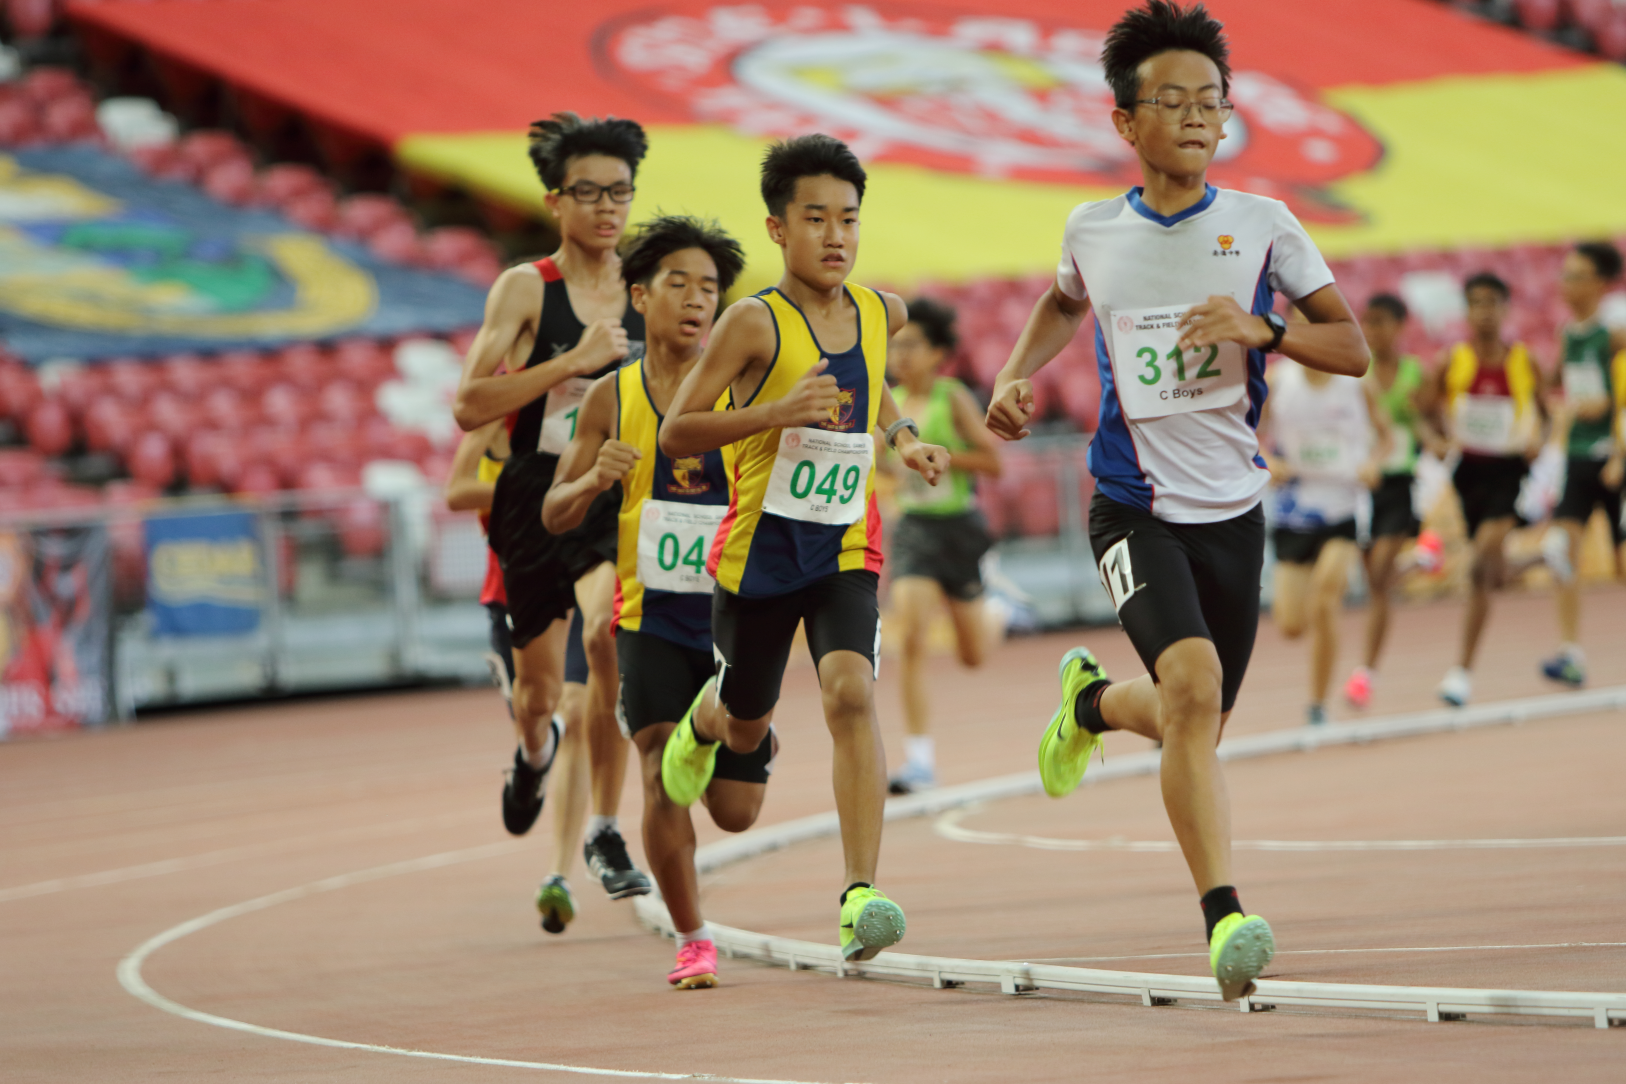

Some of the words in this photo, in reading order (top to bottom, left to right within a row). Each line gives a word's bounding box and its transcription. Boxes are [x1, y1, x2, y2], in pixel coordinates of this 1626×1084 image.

[1143, 313, 1172, 321] NATIONAL
[1136, 343, 1222, 386] 312
[1159, 390, 1168, 401] C
[1173, 387, 1203, 399] Boys
[789, 459, 860, 505] 049
[657, 532, 706, 574] 04
